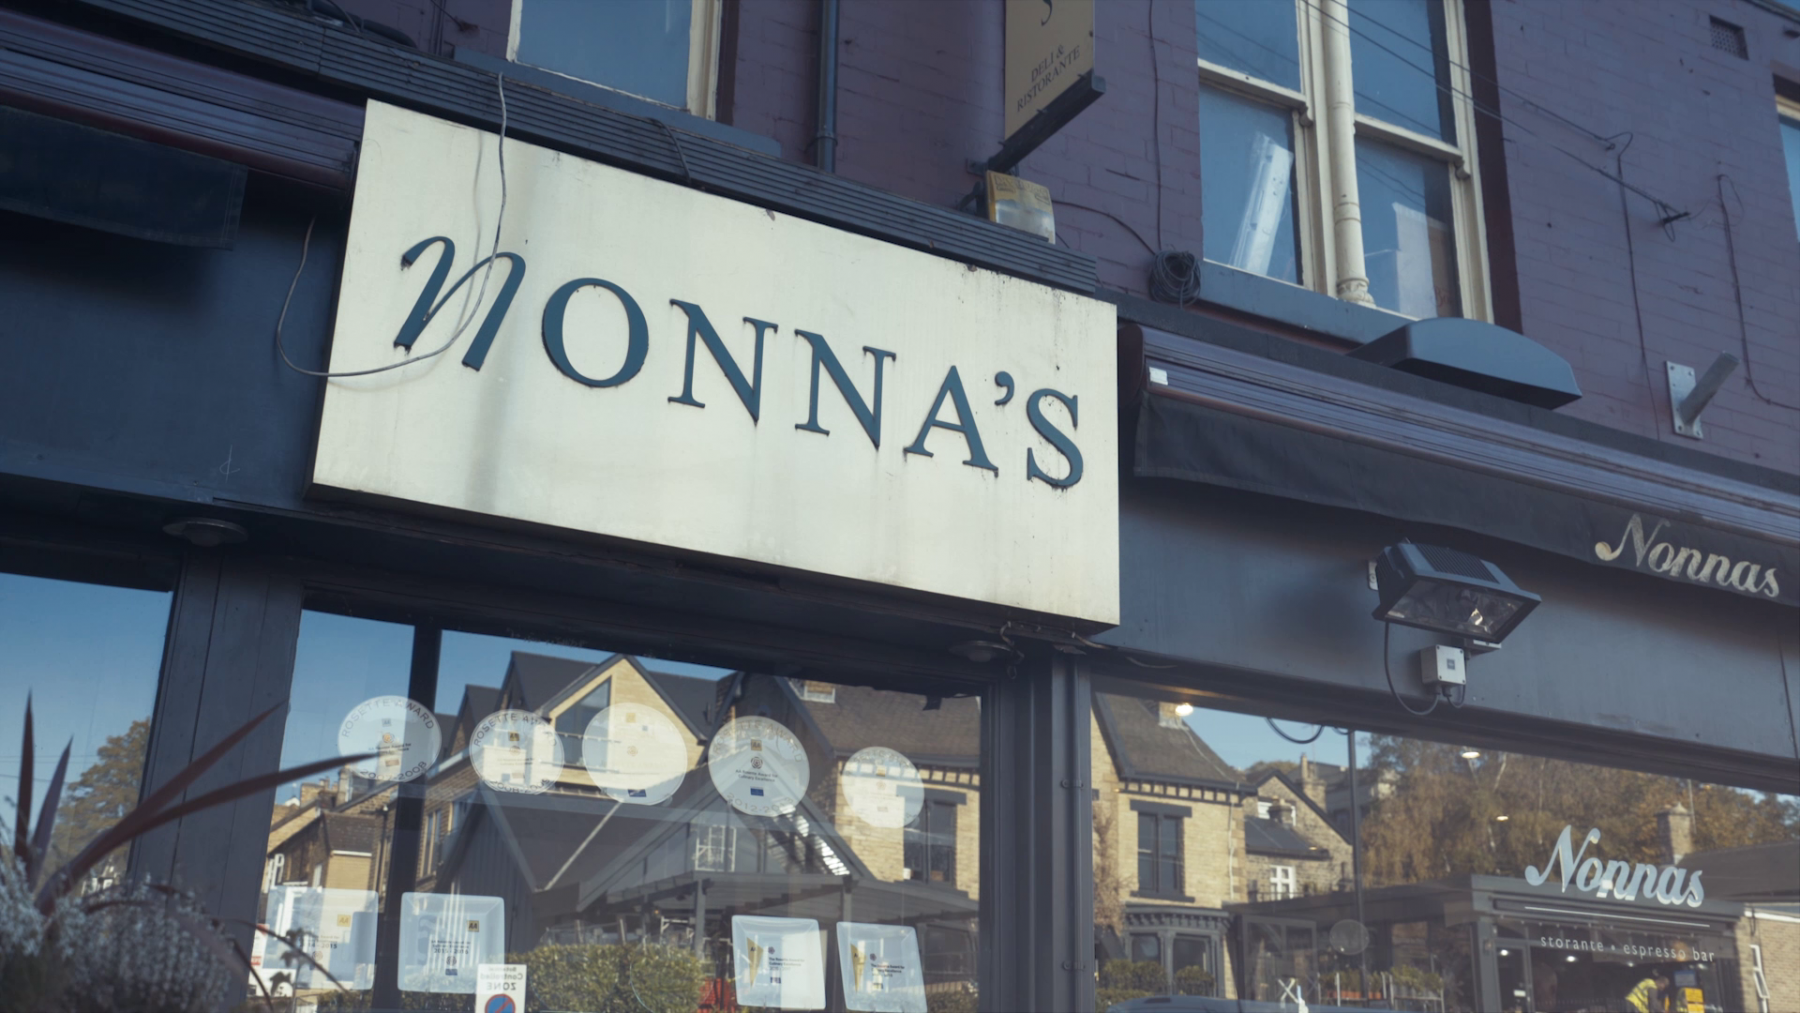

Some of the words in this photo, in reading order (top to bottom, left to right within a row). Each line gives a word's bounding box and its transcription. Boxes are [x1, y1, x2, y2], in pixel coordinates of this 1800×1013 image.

[1016, 44, 1080, 113] RISTORANTE
[1030, 51, 1054, 83] DELI
[1055, 44, 1065, 59] &
[393, 234, 1085, 490] NONNA'S
[1594, 512, 1780, 598] Nonnas
[341, 697, 391, 738] ROSETTE
[394, 698, 435, 730] AWARD
[473, 712, 518, 748] ROSETTE
[713, 719, 761, 754] ROSTTE
[1524, 824, 1705, 908] Nonnas
[1540, 934, 1604, 953] storante
[1623, 942, 1686, 961] espresso
[1692, 946, 1715, 963] bar
